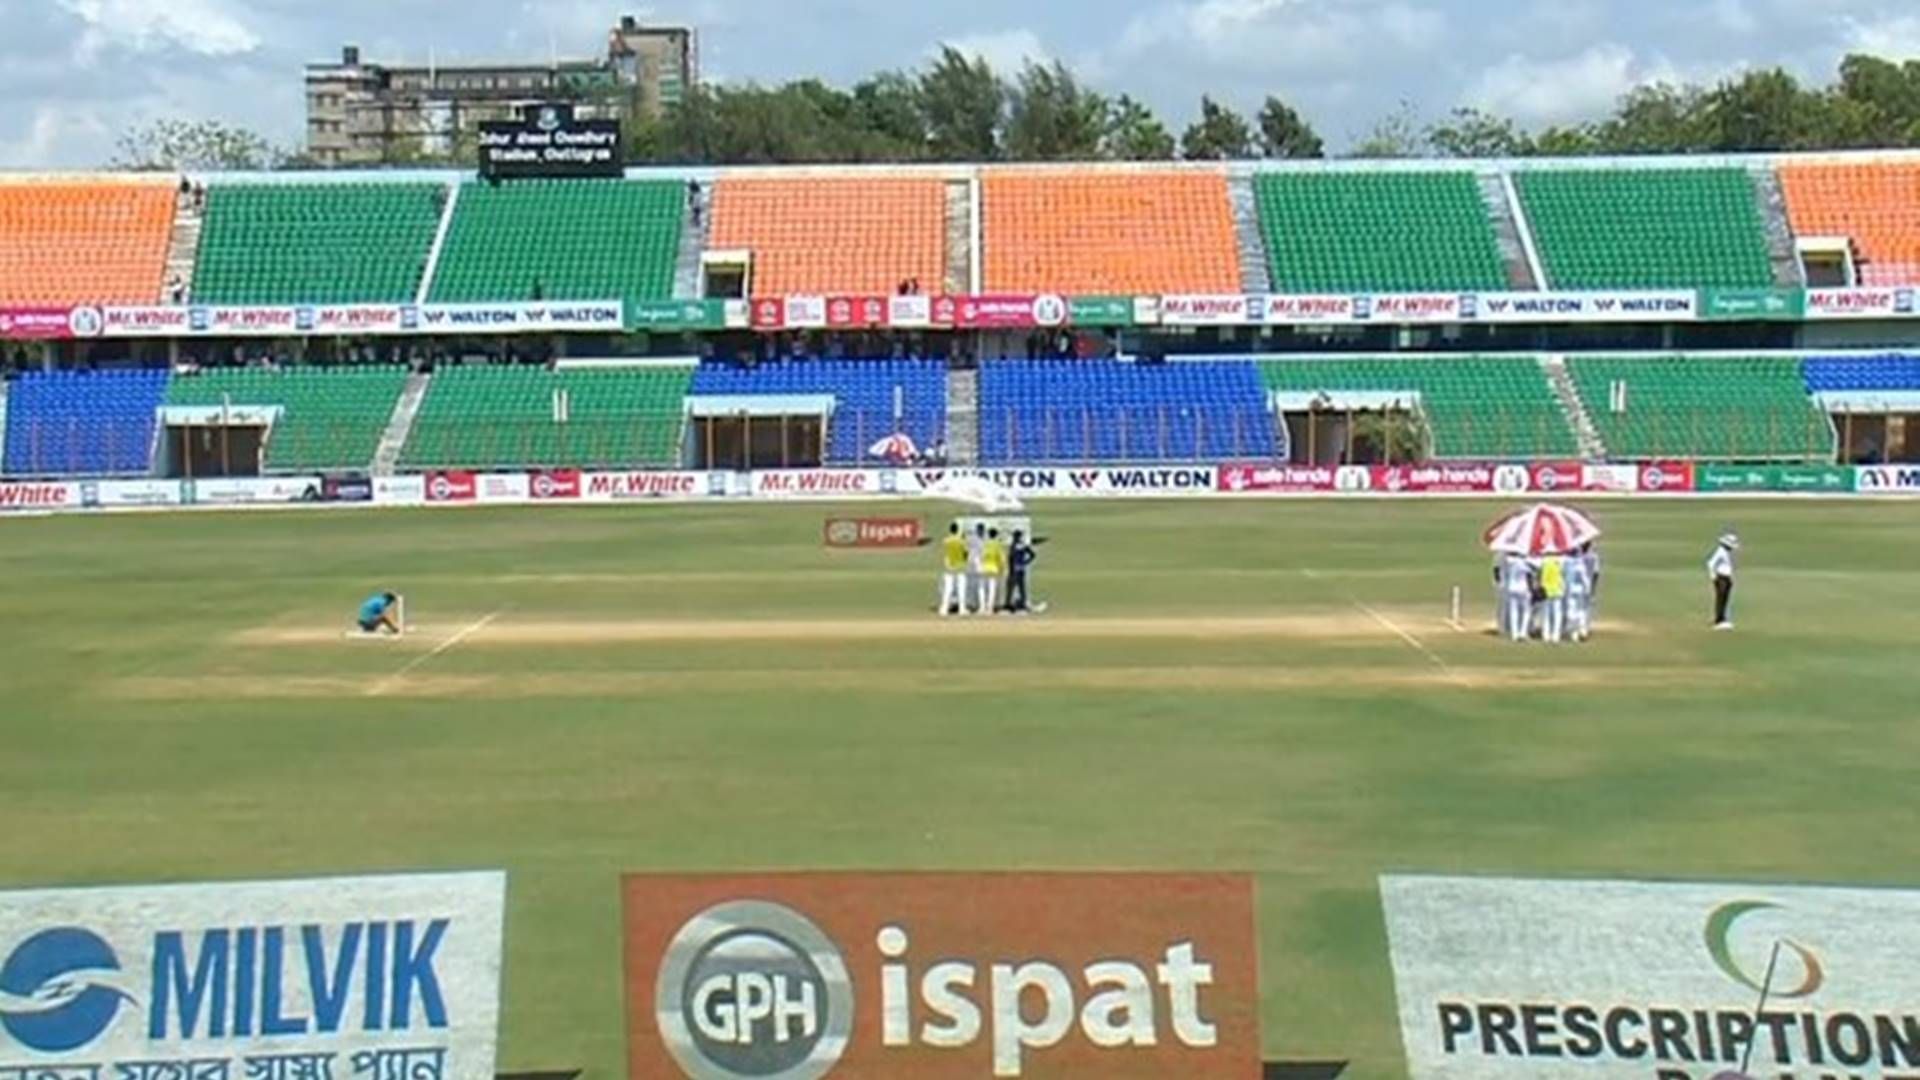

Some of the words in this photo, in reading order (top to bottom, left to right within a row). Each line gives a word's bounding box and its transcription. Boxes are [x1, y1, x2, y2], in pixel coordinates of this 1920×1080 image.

[1513, 299, 1582, 312] WALTON
[1620, 298, 1689, 311] WALTON
[449, 310, 516, 323] WALTON
[551, 308, 617, 321] WALTON
[1108, 470, 1211, 488] WALTON
[148, 919, 451, 1039] MILVIK
[692, 972, 817, 1044] GPH
[876, 925, 1217, 1077] ispat
[1437, 1001, 1920, 1067] PRESCRIPTION
